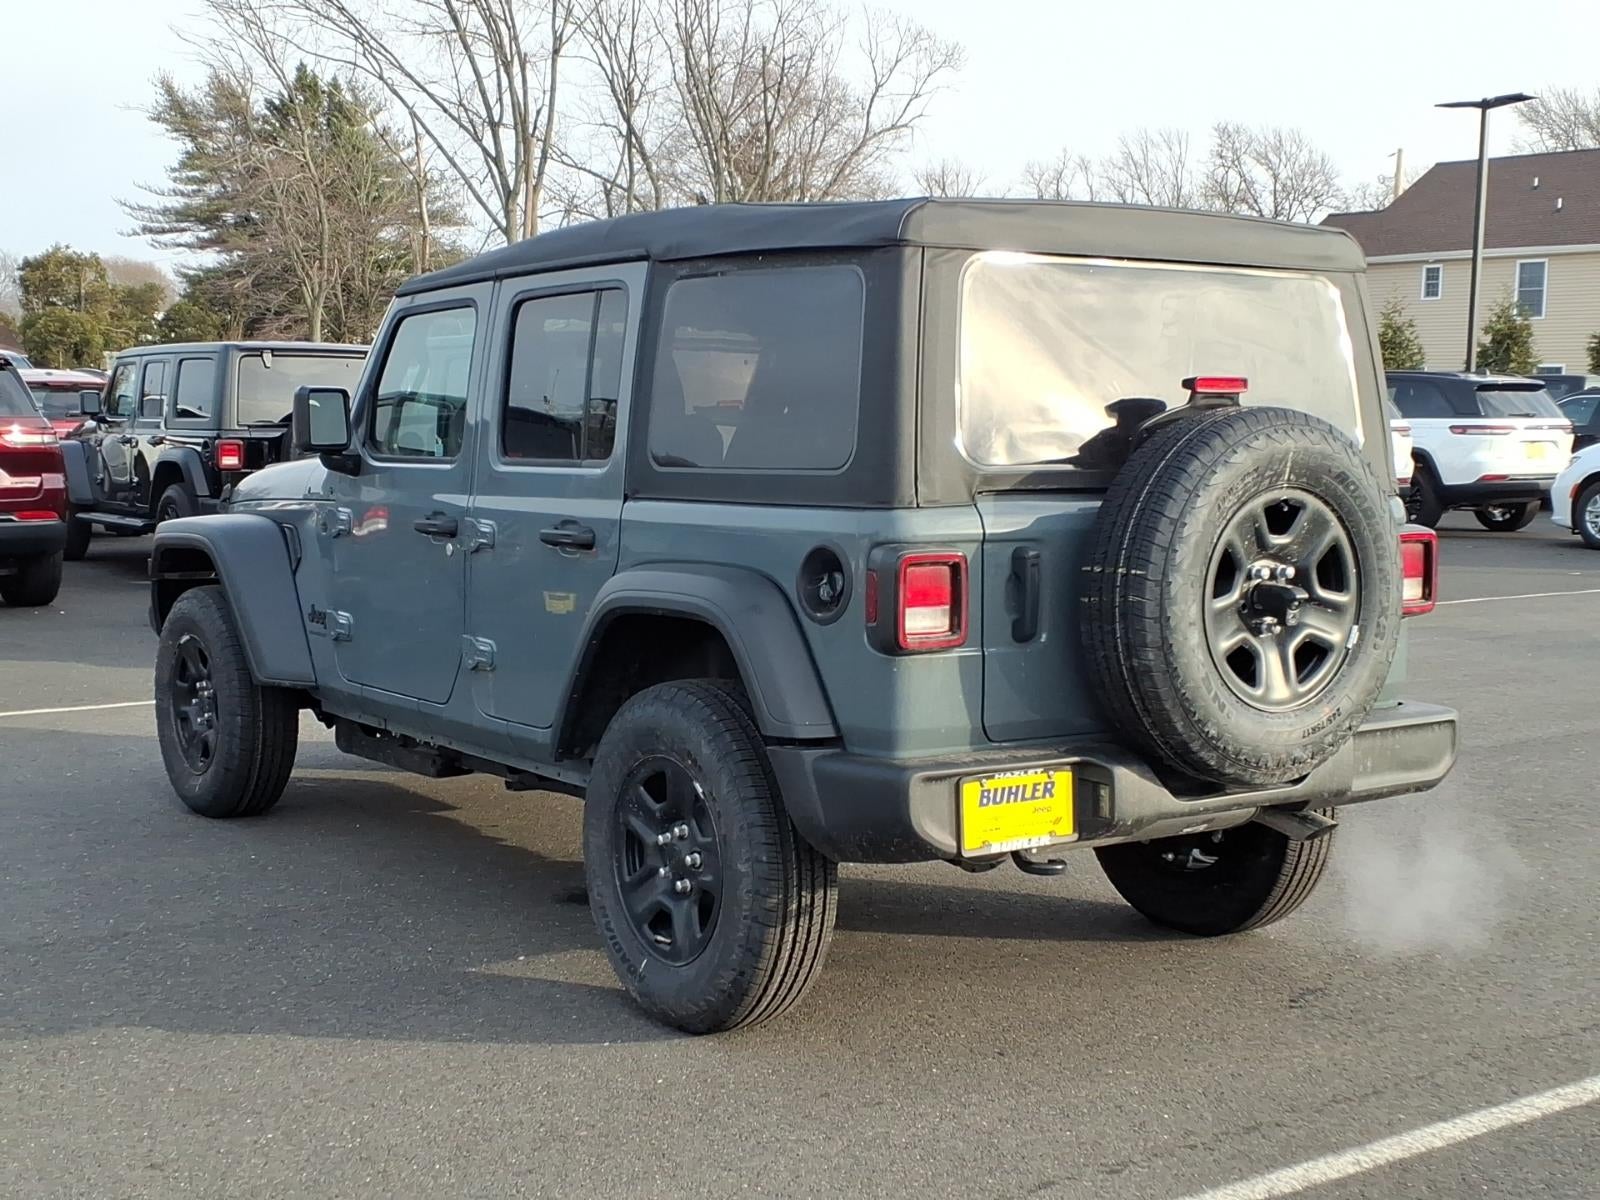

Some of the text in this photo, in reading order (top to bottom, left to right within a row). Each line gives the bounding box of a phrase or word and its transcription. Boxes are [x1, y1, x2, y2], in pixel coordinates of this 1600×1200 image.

[1302, 707, 1341, 738] 245/75R17
[978, 780, 1055, 807] BUHLER
[1032, 805, 1052, 814] Jeep
